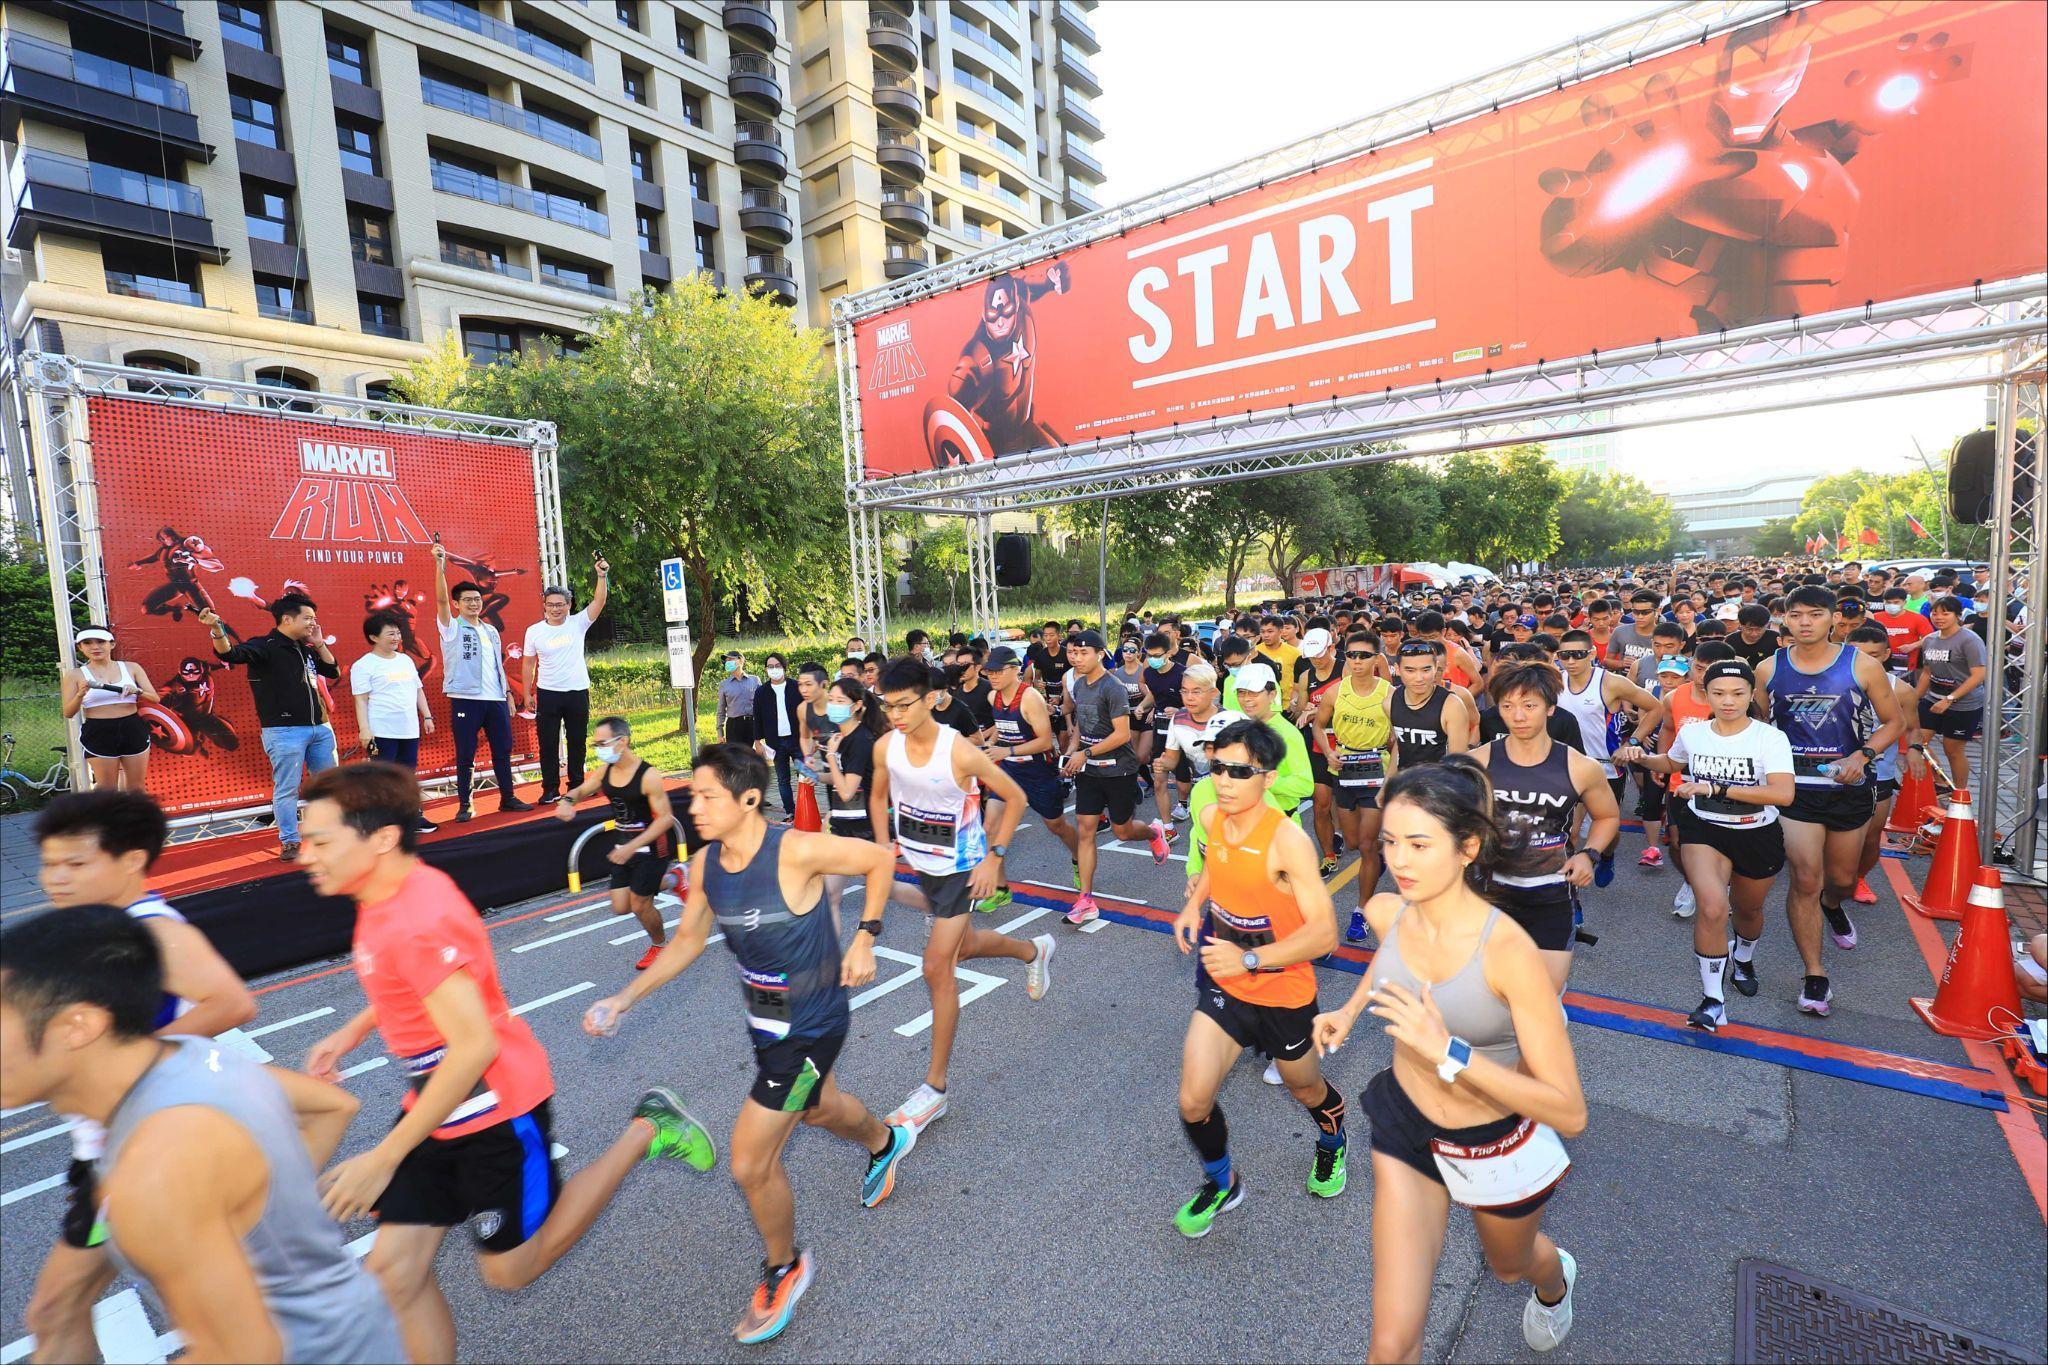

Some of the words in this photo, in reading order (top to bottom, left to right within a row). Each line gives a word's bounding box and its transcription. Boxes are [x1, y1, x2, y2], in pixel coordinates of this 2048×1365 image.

[1127, 184, 1434, 364] START
[878, 322, 910, 347] MARVEL
[868, 343, 927, 390] RUN
[302, 442, 392, 477] MARVEL
[269, 478, 433, 544] RUN
[305, 549, 332, 563] FIND
[335, 550, 365, 564] YOUR
[368, 550, 404, 564] POWER
[1924, 649, 1951, 663] MARVEL
[1694, 753, 1756, 782] MARVEL
[1493, 789, 1568, 807] RUN
[1243, 918, 1267, 926] POWER
[1469, 1146, 1496, 1158] FIND
[1499, 1133, 1519, 1153] YOUR
